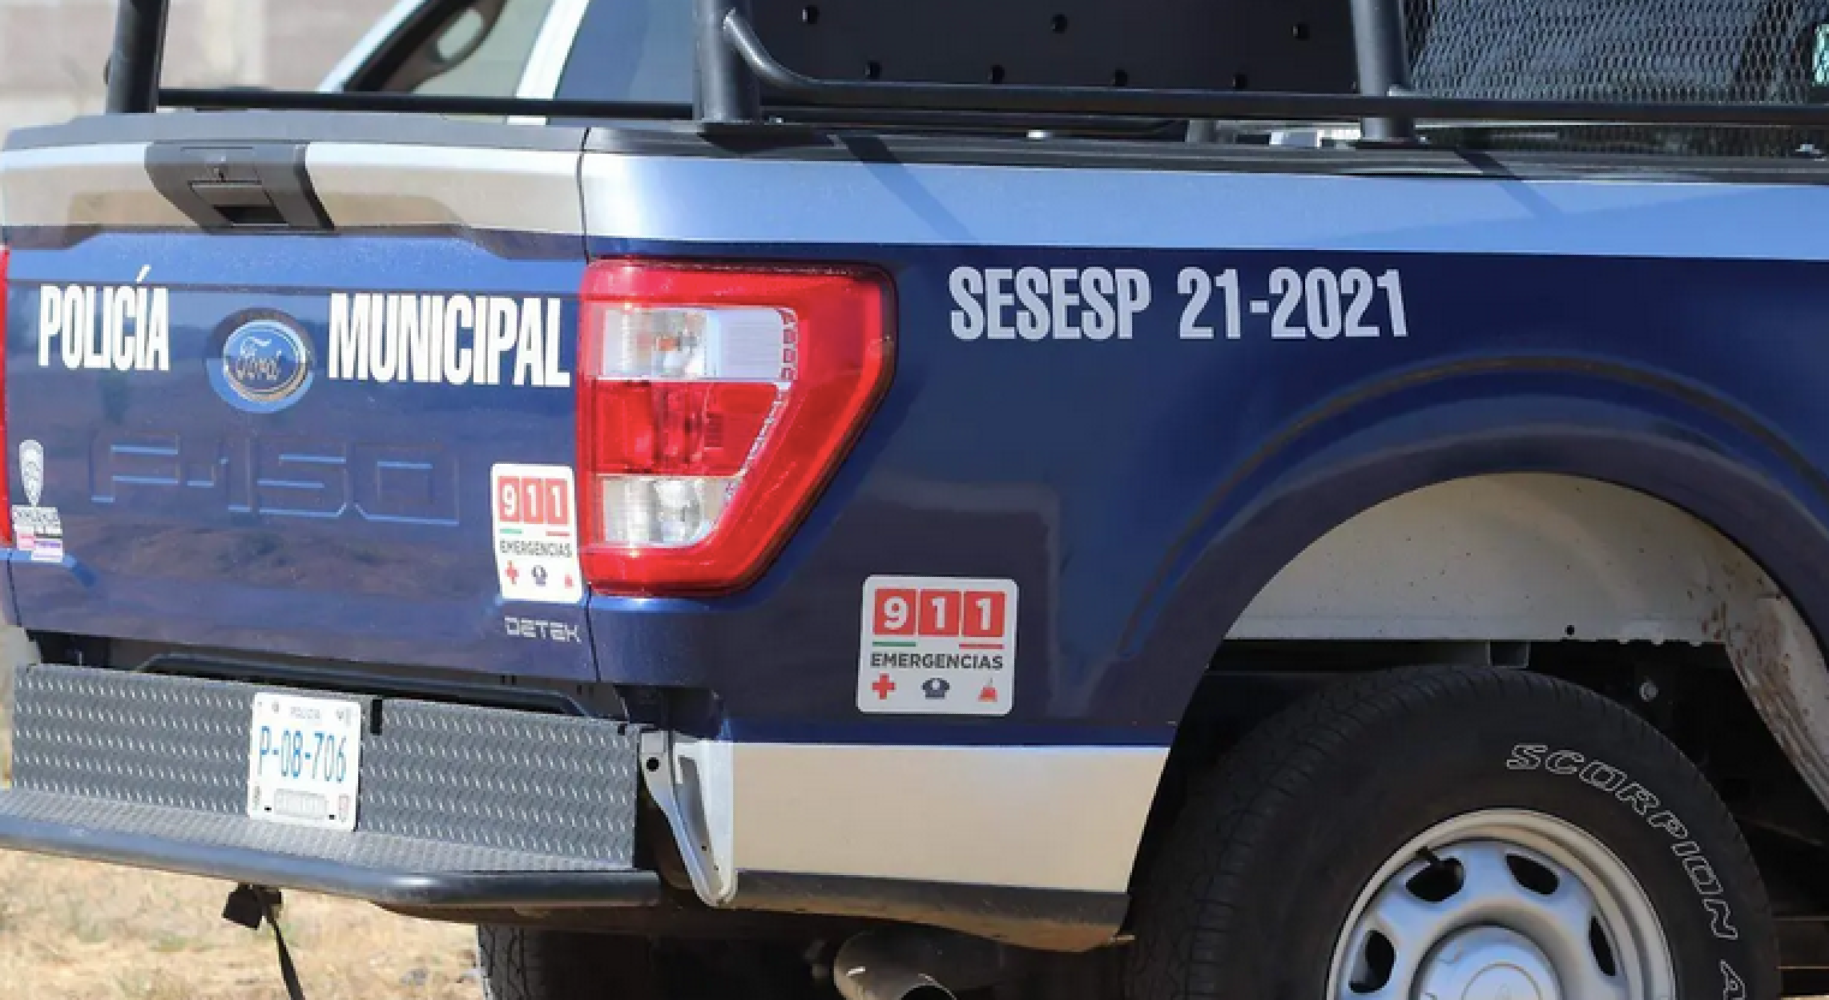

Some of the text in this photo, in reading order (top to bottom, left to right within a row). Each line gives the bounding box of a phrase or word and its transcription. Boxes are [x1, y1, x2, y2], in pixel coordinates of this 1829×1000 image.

[38, 264, 570, 387] POLICÍA MUNICIPAL
[948, 266, 1408, 341] SESESP 21-2021
[89, 431, 459, 526] F-150
[502, 483, 562, 519] 911
[499, 539, 573, 558] EMERGENCIAS
[883, 596, 992, 631] 911
[869, 653, 1004, 669] EMERGENCIAS
[257, 725, 347, 782] P-08-706
[1506, 744, 1738, 940] SCORPION
